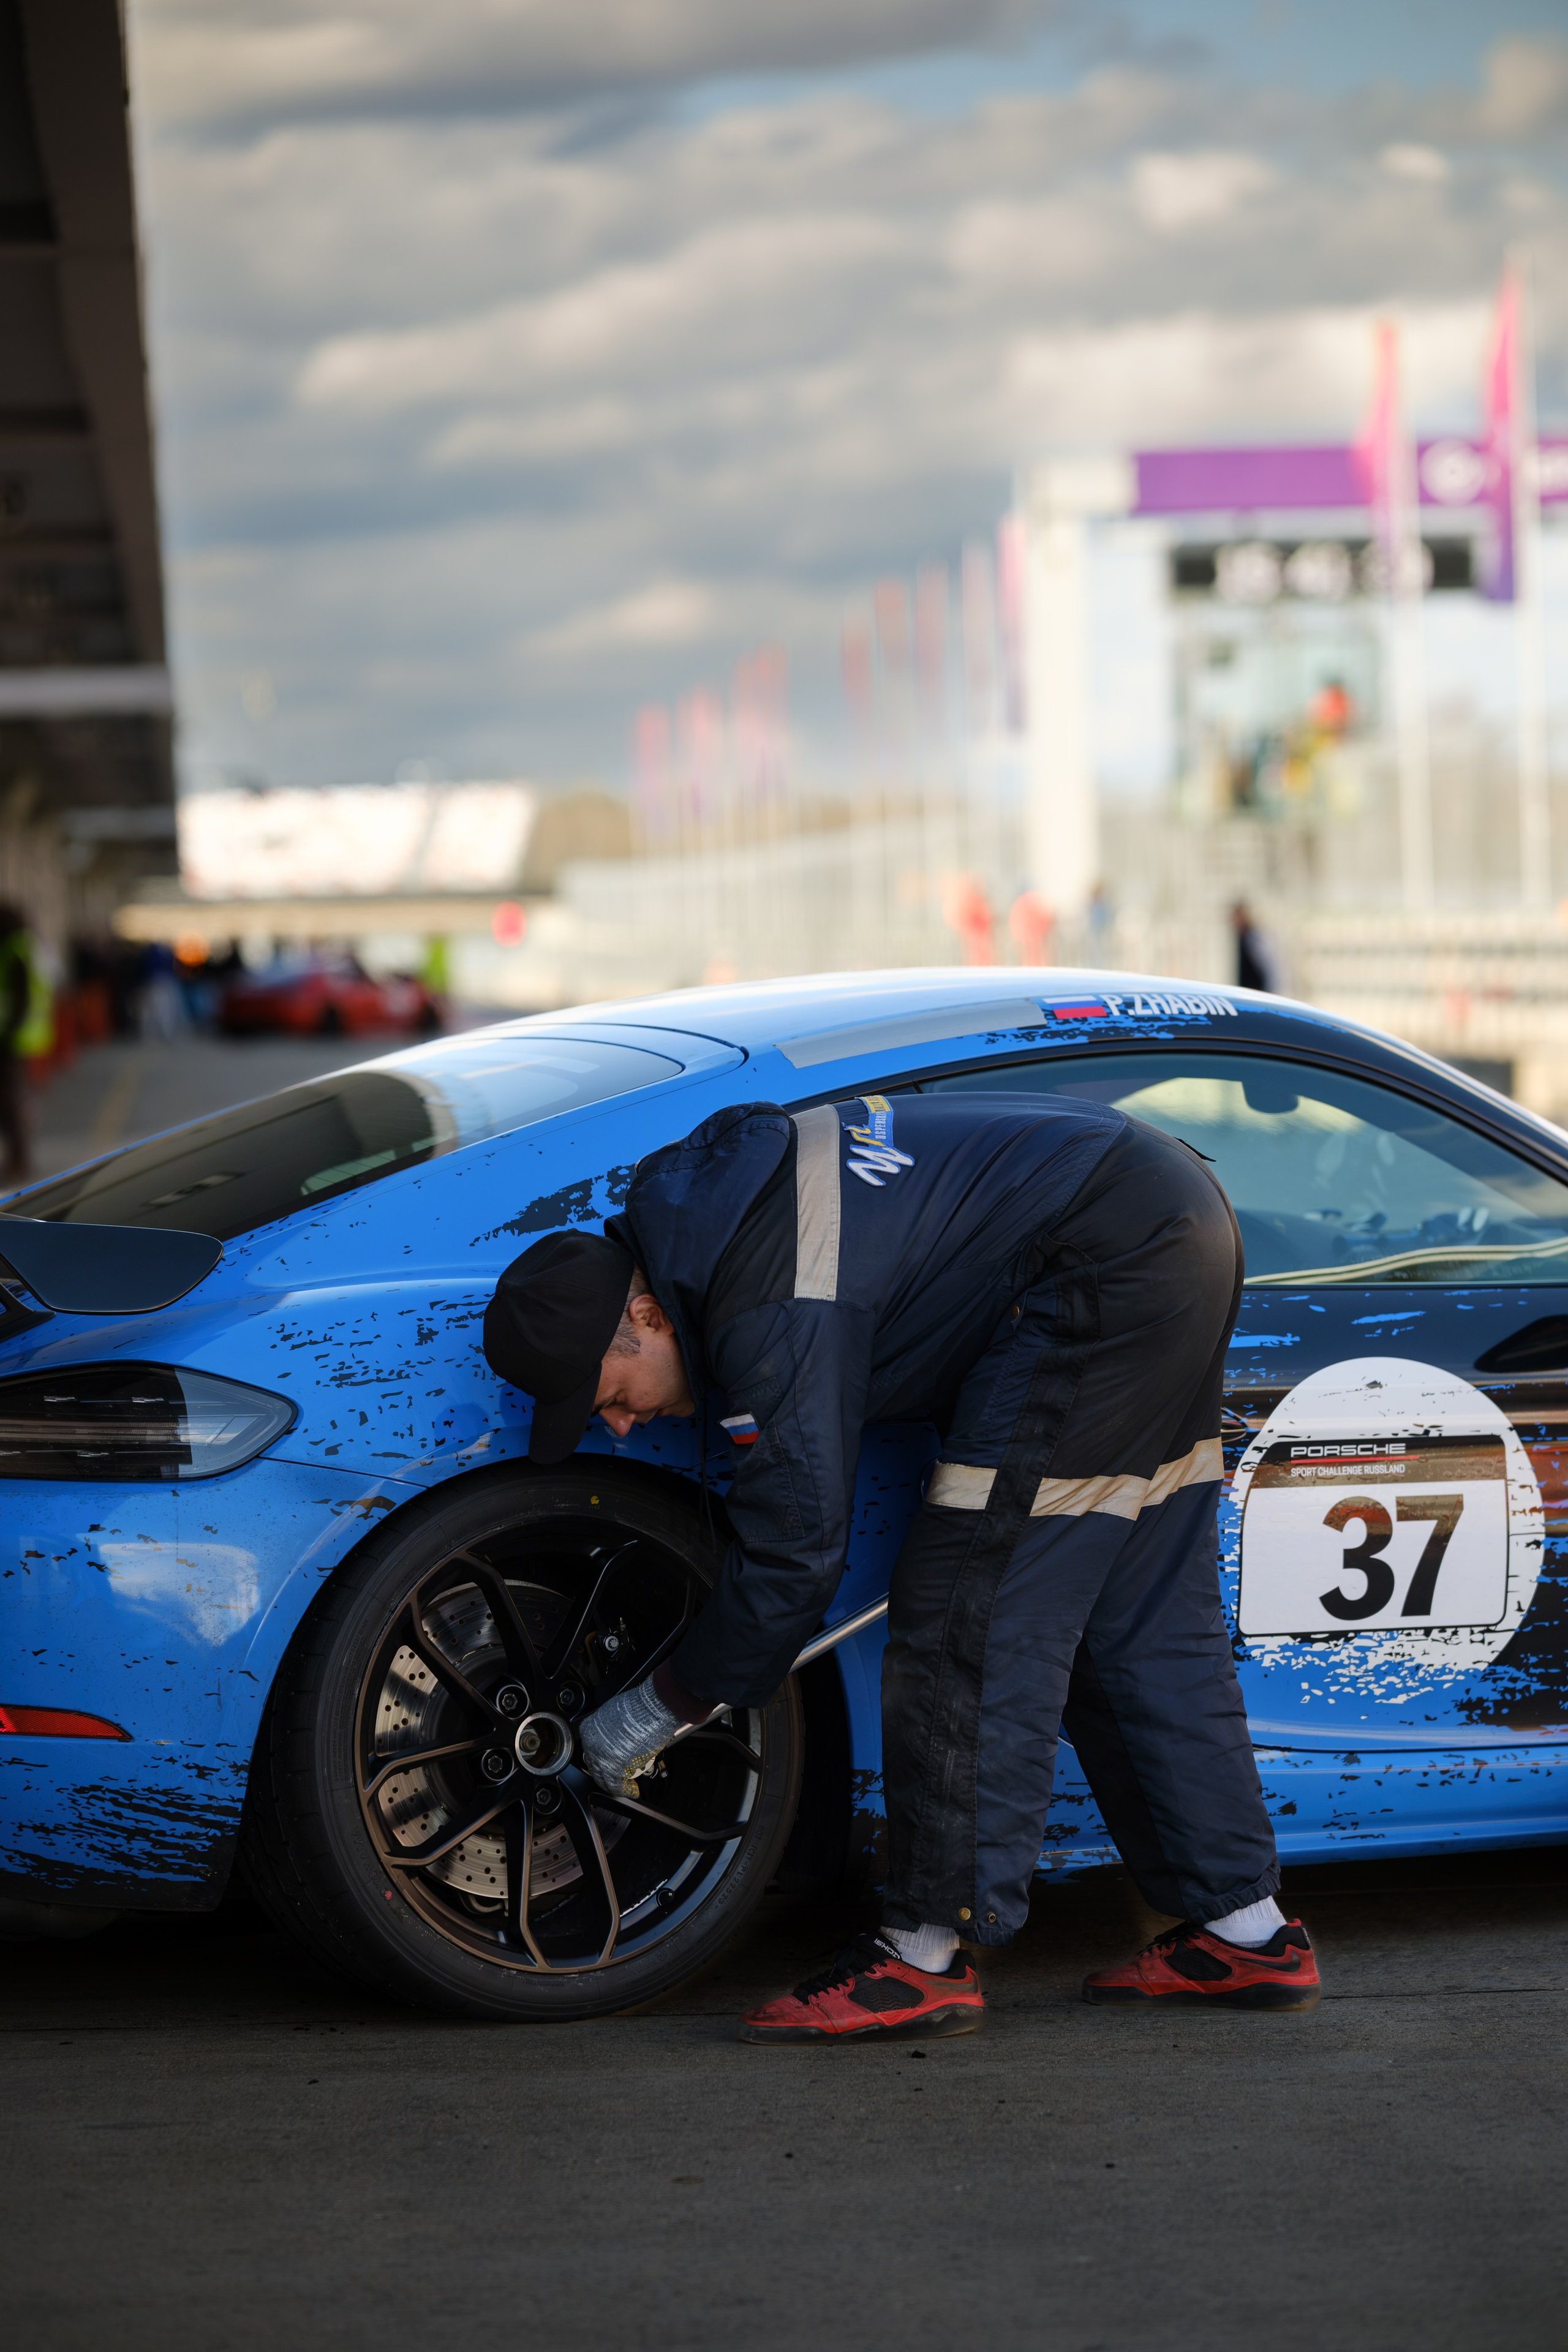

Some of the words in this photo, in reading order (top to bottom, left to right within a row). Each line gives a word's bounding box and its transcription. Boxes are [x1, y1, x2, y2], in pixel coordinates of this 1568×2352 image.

[1099, 994, 1238, 1016] P.ZHABIN
[1291, 1443, 1406, 1458] PORSCHE
[1291, 1466, 1317, 1477] SPORT
[1317, 1465, 1363, 1476] CHALLENGE
[1364, 1463, 1405, 1474] RUSSLAND
[1319, 1494, 1464, 1621] 37
